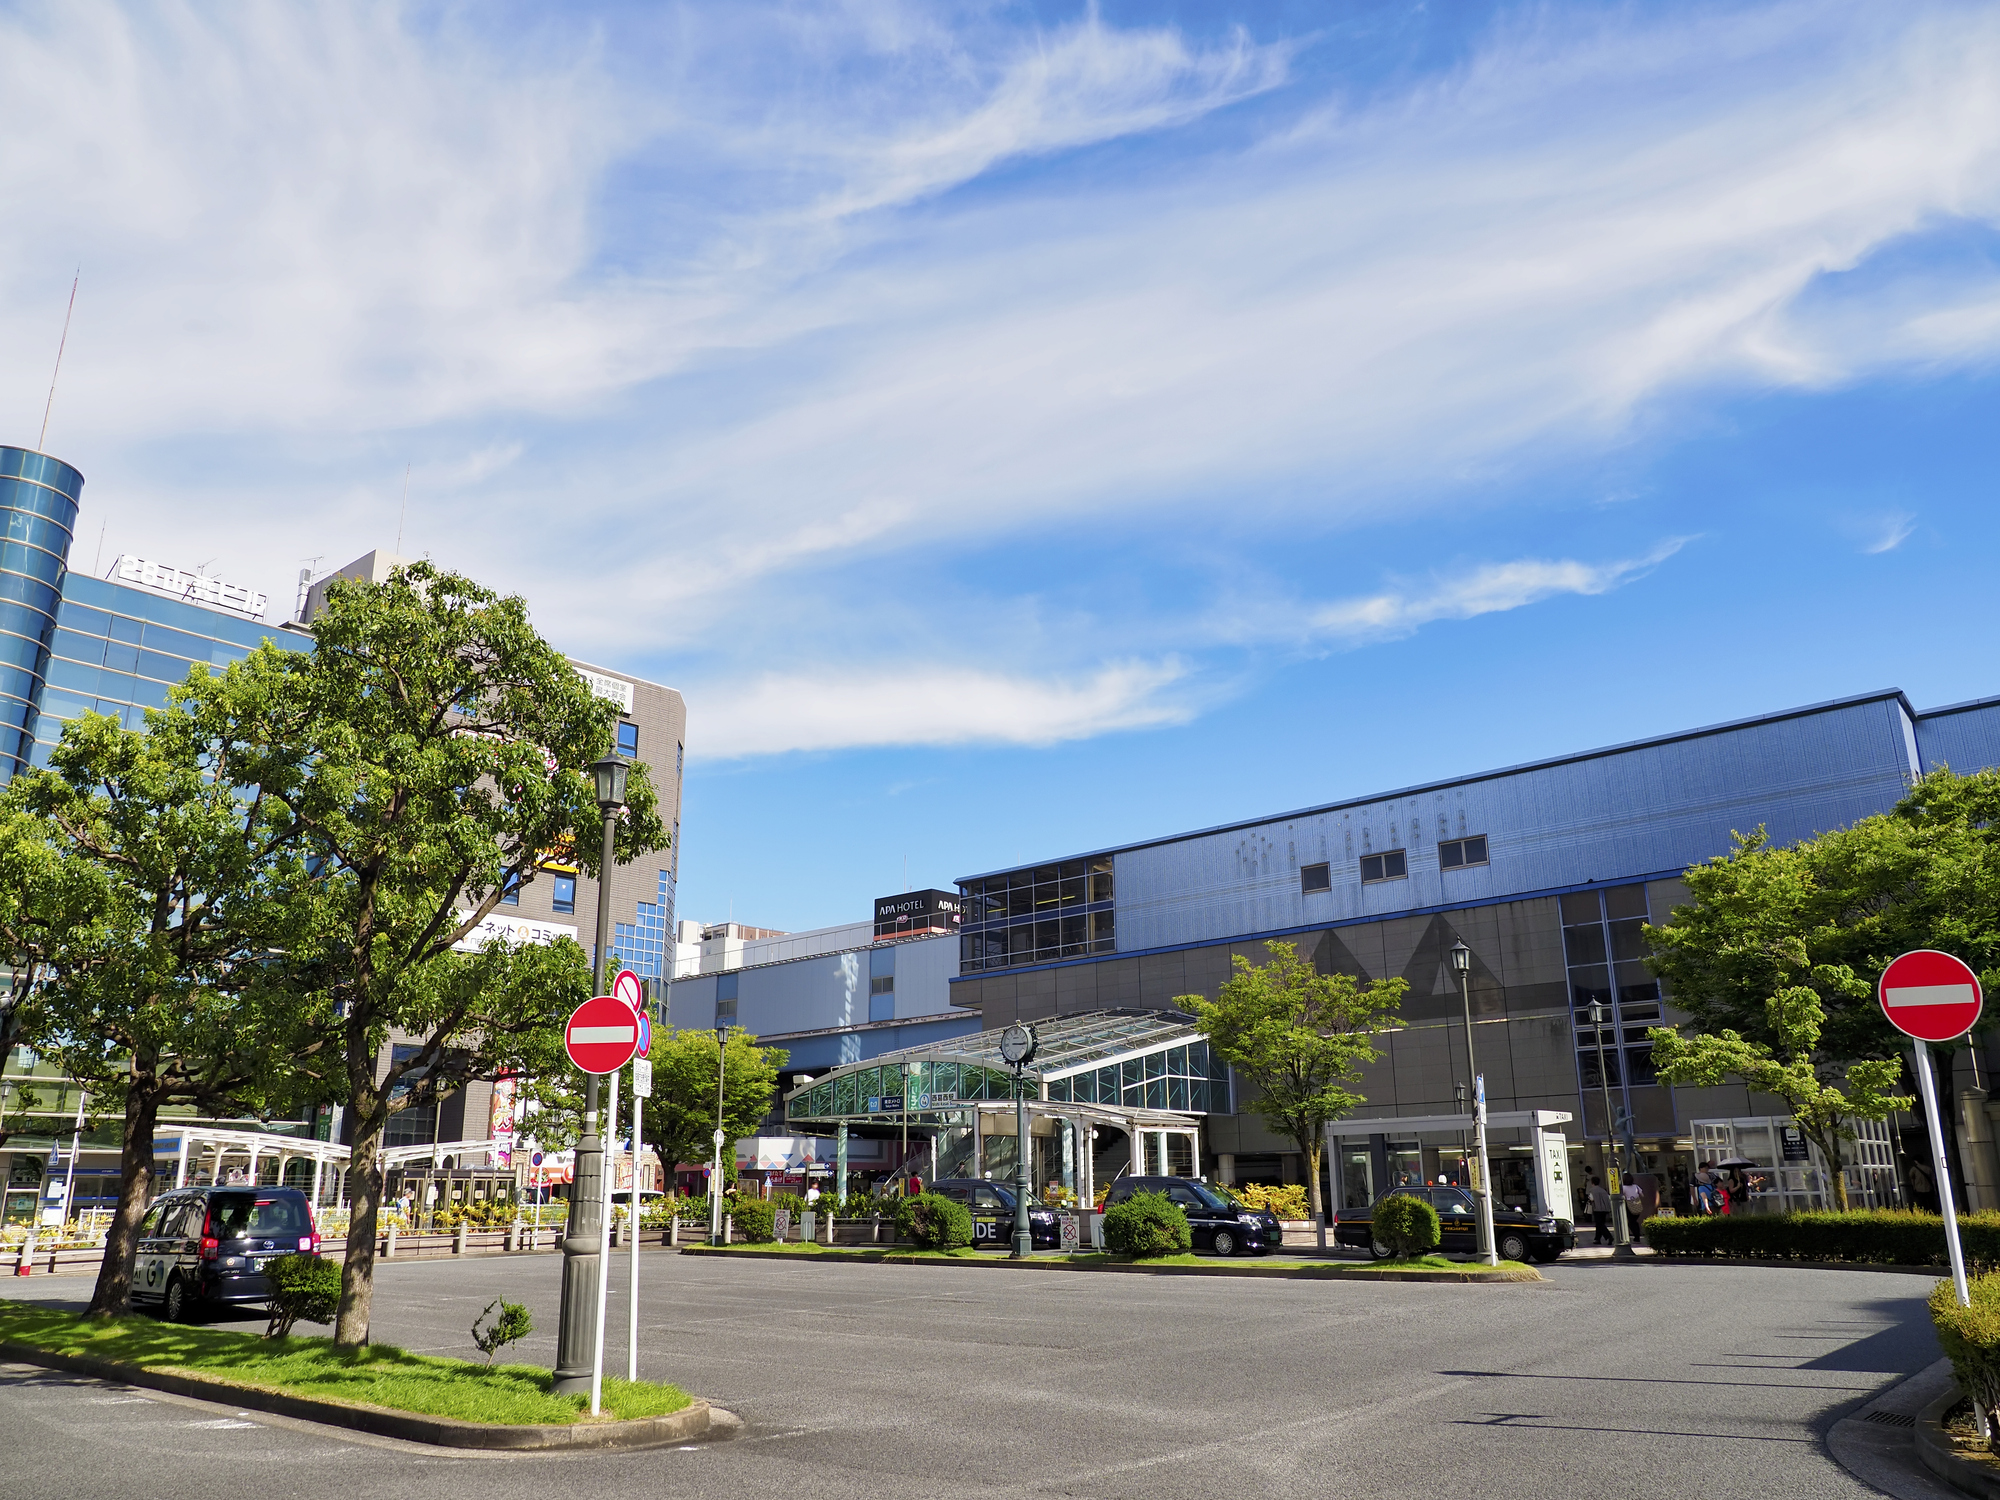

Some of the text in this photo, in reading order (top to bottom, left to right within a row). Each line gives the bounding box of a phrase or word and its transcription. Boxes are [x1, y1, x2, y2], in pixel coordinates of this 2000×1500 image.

[879, 900, 924, 916] APA HOTEL
[1549, 1149, 1562, 1160] TAXI
[972, 1222, 997, 1239] IDE
